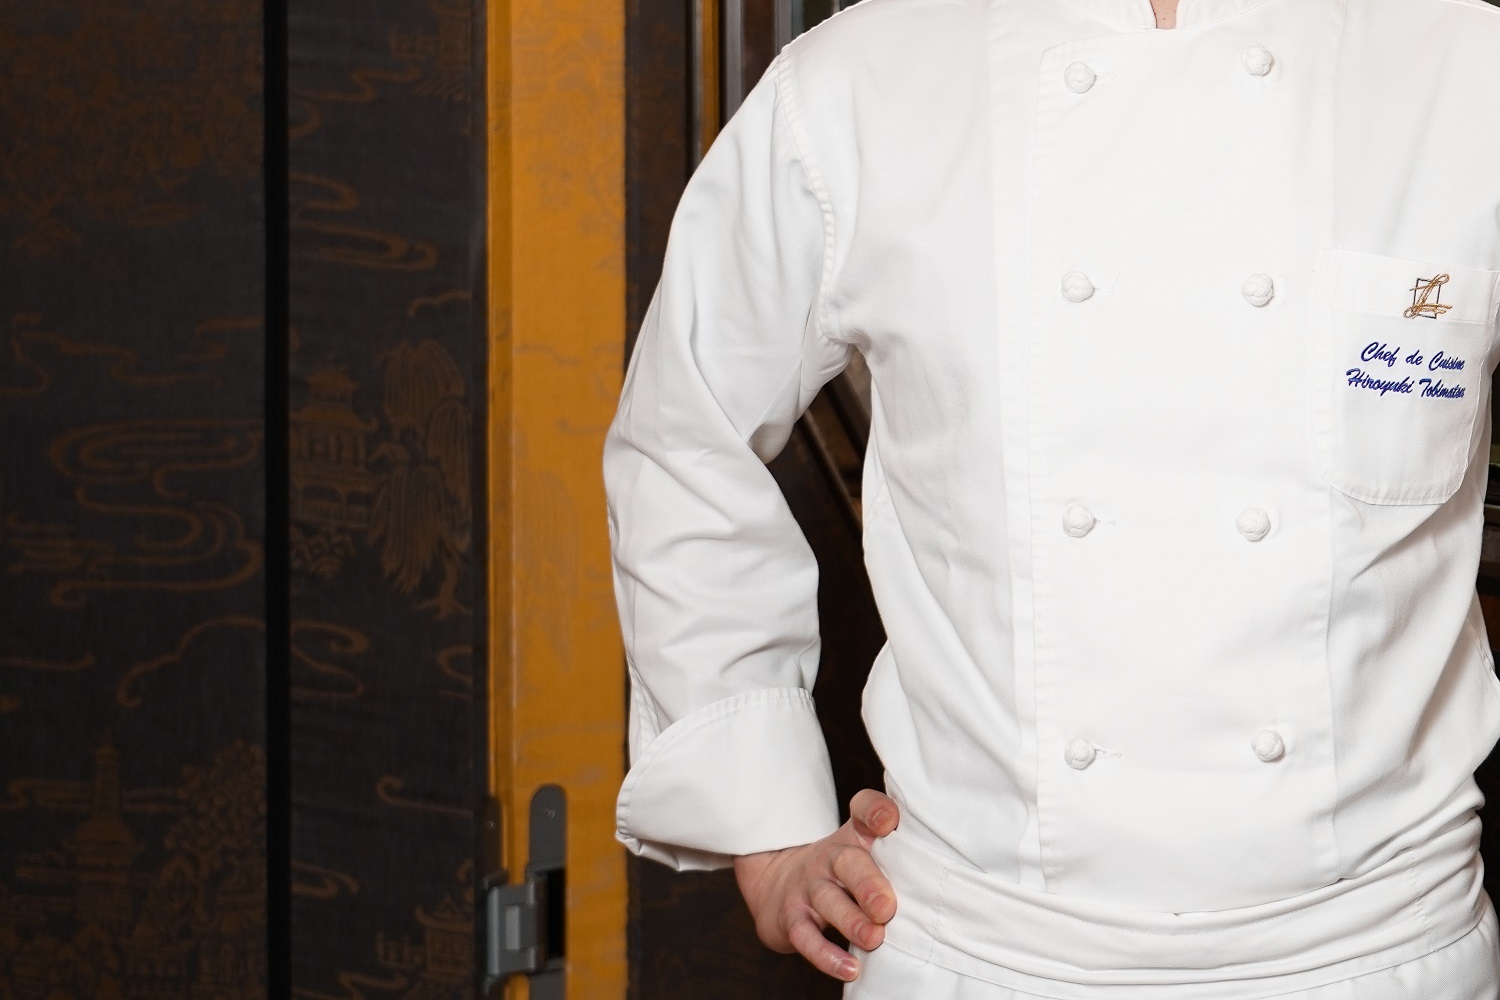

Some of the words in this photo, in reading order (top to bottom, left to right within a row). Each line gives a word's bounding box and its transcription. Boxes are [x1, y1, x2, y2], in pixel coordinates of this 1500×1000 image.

[1360, 341, 1401, 367] Chef
[1405, 349, 1424, 366] de
[1345, 367, 1415, 397] Hiroyuki
